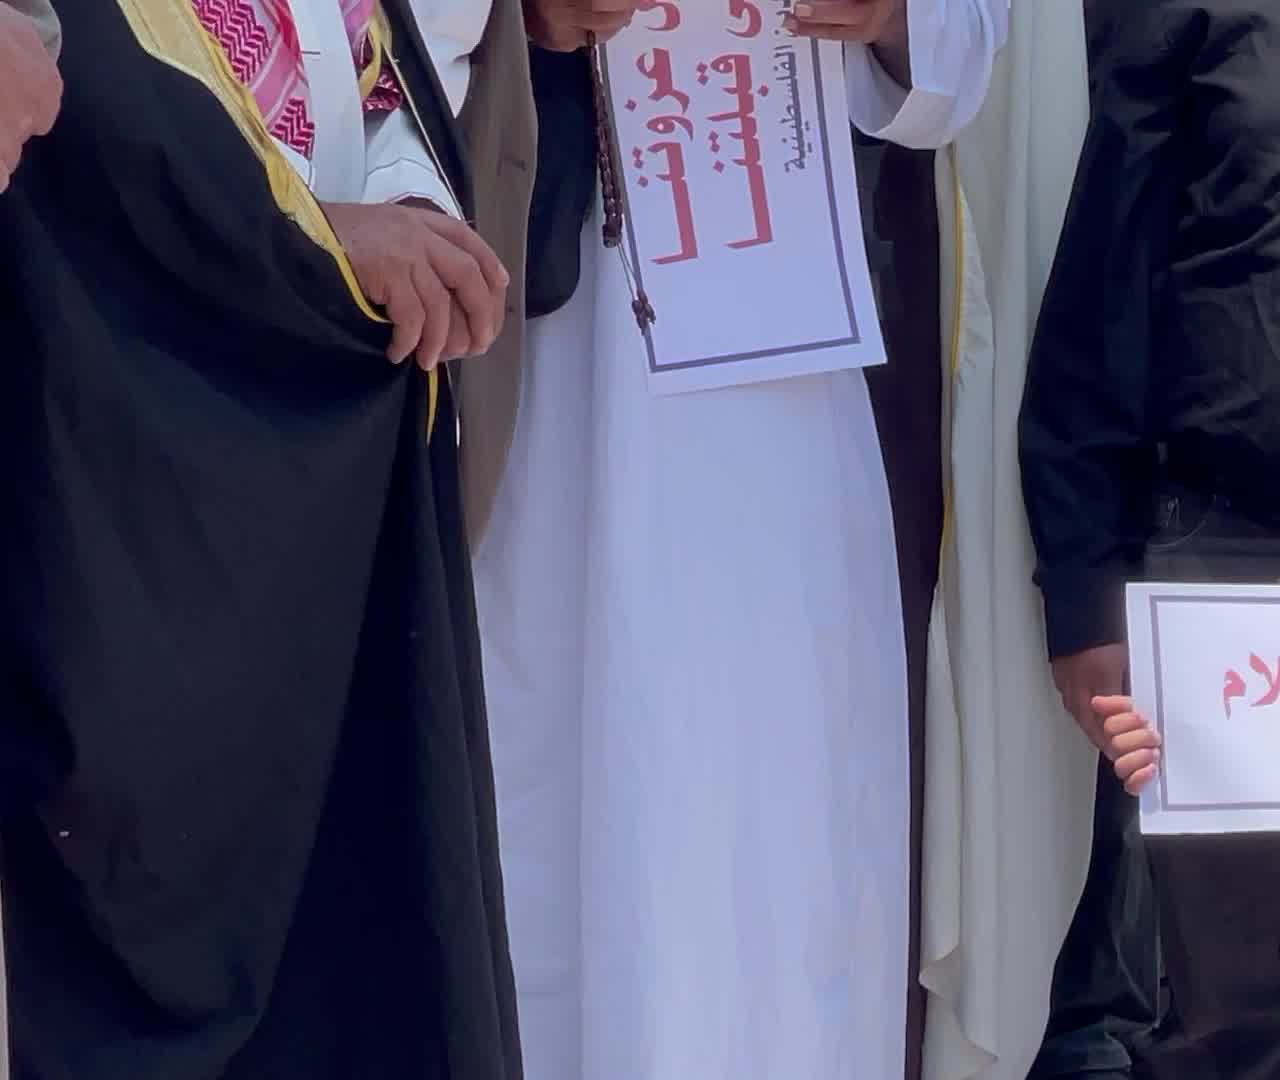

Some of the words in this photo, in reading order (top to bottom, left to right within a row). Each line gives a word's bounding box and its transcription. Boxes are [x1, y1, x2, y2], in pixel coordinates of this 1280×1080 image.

[623, 47, 699, 265] عزوتنا
[696, 53, 774, 250] قبلتنا
[773, 43, 814, 173] الفلسطينية
